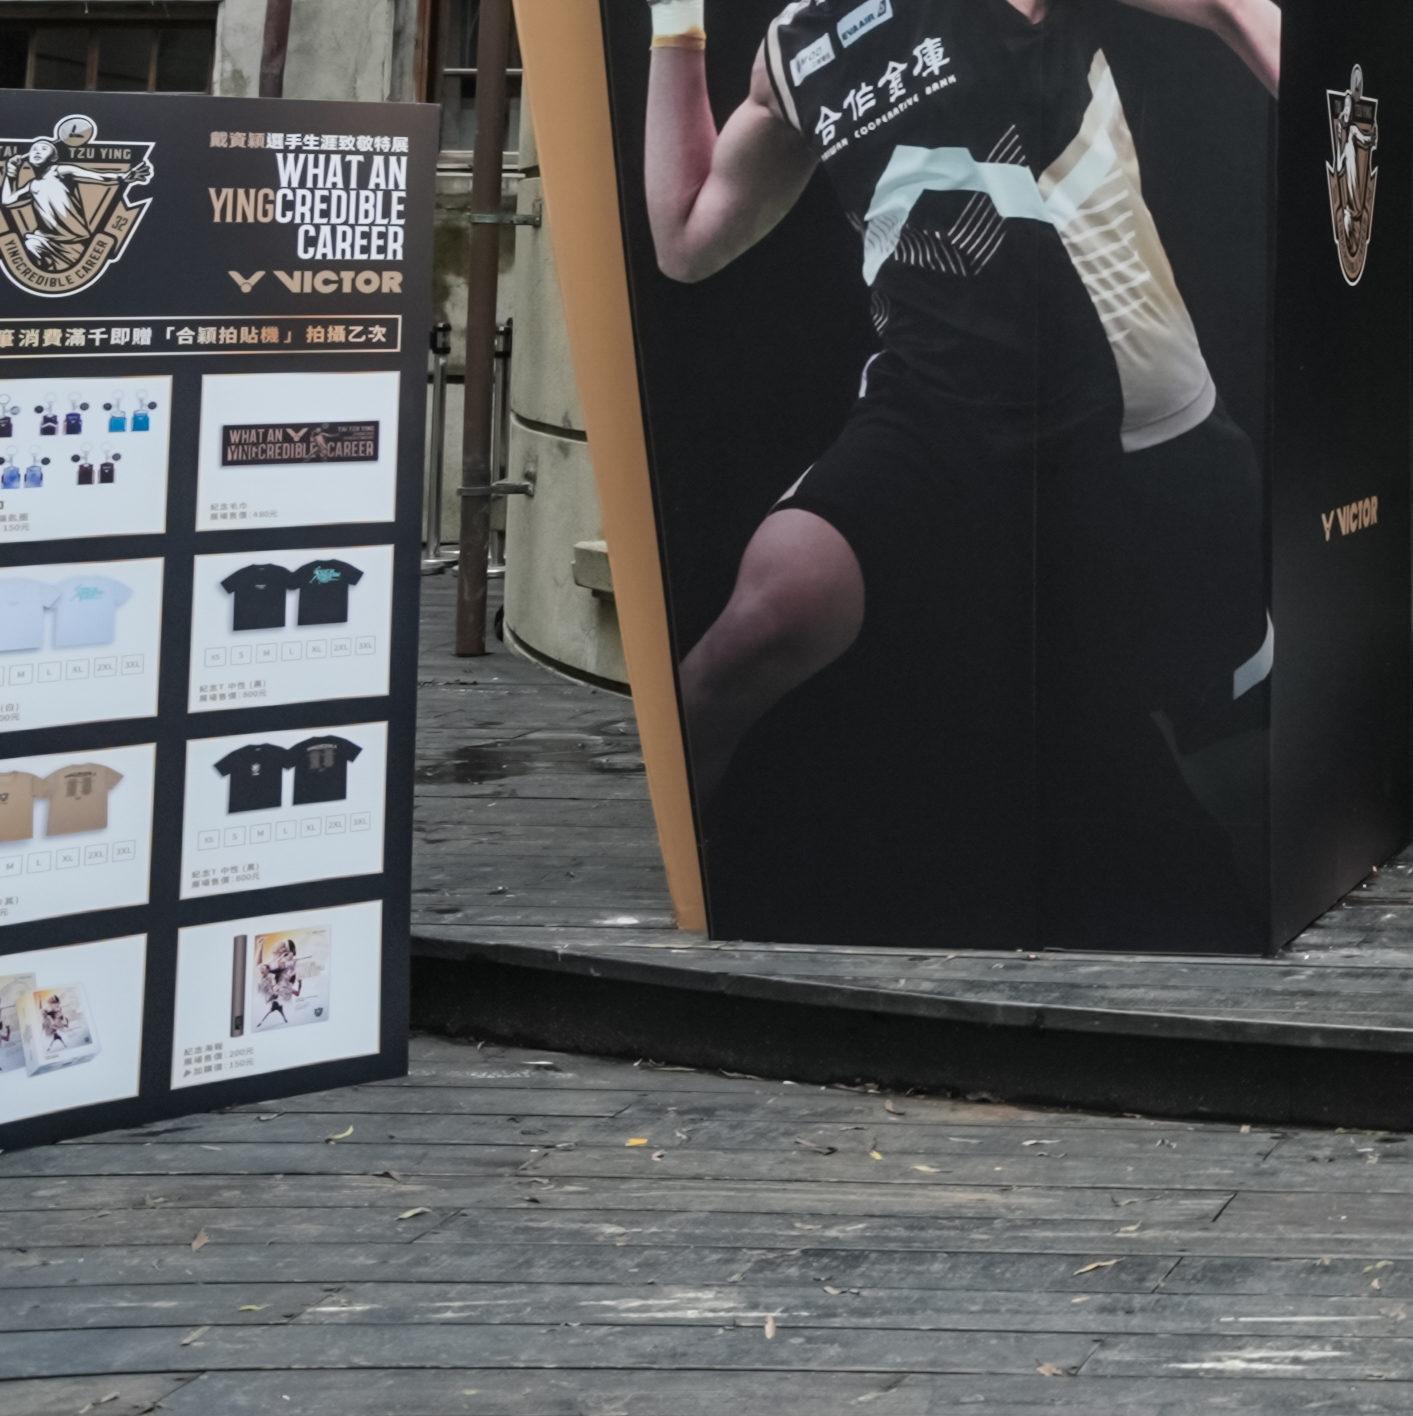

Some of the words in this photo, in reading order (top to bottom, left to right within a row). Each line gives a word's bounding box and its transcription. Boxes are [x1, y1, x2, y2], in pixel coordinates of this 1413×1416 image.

[68, 147, 95, 158] TZU
[100, 148, 131, 159] YING
[209, 131, 409, 153] 戴資穎選手生涯致敬特展
[275, 152, 364, 189] WHAT
[368, 155, 408, 190] AN
[112, 215, 129, 232] 32
[208, 187, 406, 225] YINGCREDIBLE
[297, 224, 404, 261] CAREER
[4, 239, 75, 288] YINGCREDIBLE
[75, 240, 108, 279] CAREER
[273, 270, 403, 294] VICTOR
[1336, 495, 1378, 536] VICTOR
